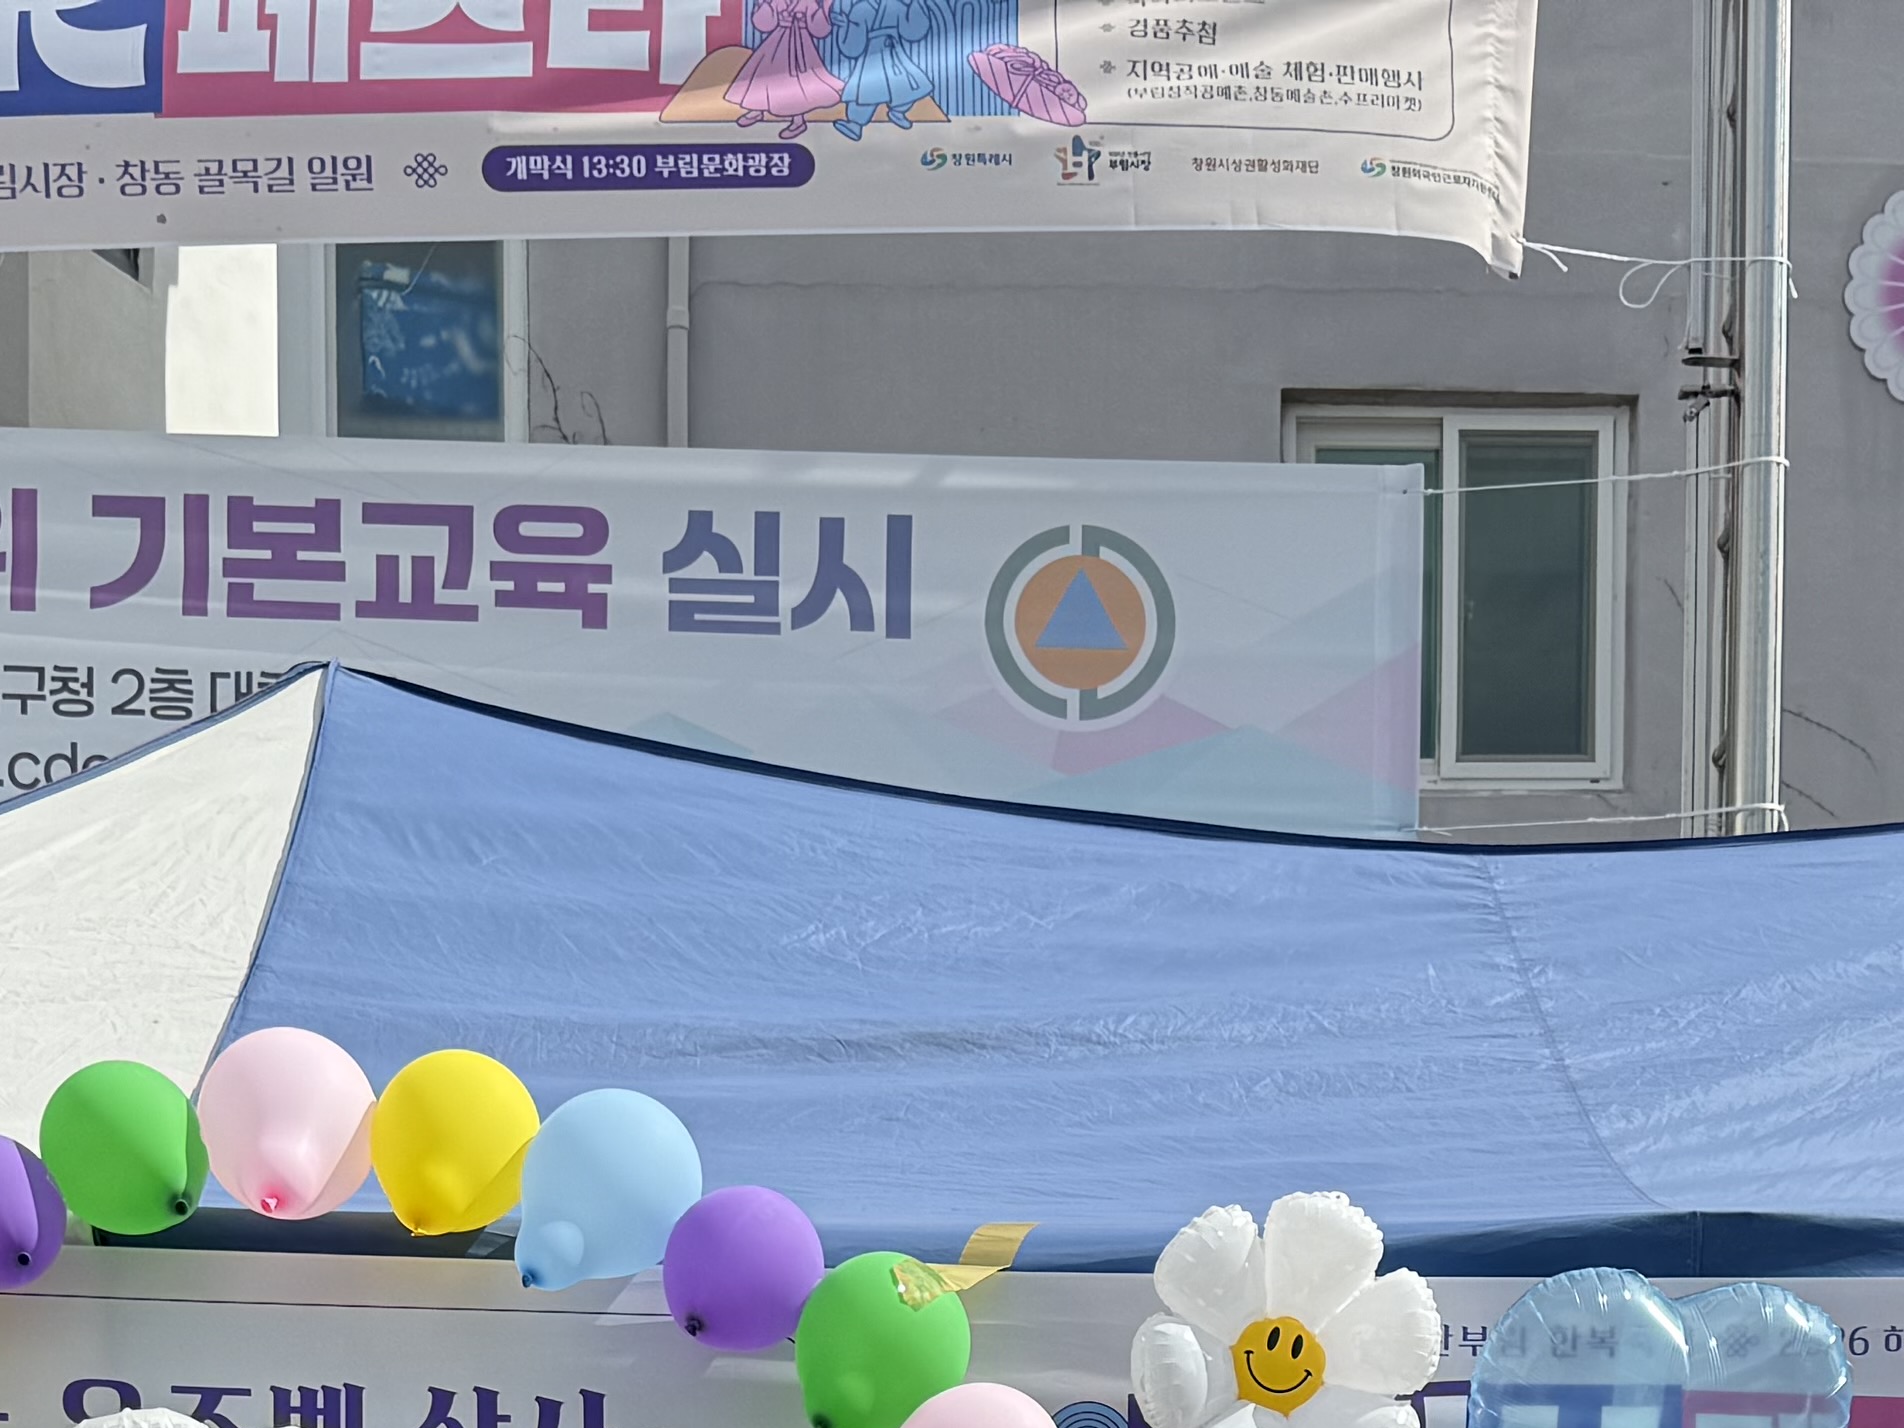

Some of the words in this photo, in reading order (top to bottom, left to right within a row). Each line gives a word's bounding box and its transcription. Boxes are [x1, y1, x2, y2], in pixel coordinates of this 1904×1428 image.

[1128, 18, 1217, 45] 경품추첨
[115, 159, 185, 197] 창동
[194, 156, 296, 195] 골목길
[307, 154, 375, 193] 일원
[505, 153, 573, 180] 개막식
[582, 154, 647, 179] 13:30
[654, 152, 791, 180] 부림문화광장
[90, 493, 613, 630] 기본교육
[662, 507, 914, 640] 실시
[110, 666, 194, 721] 2층
